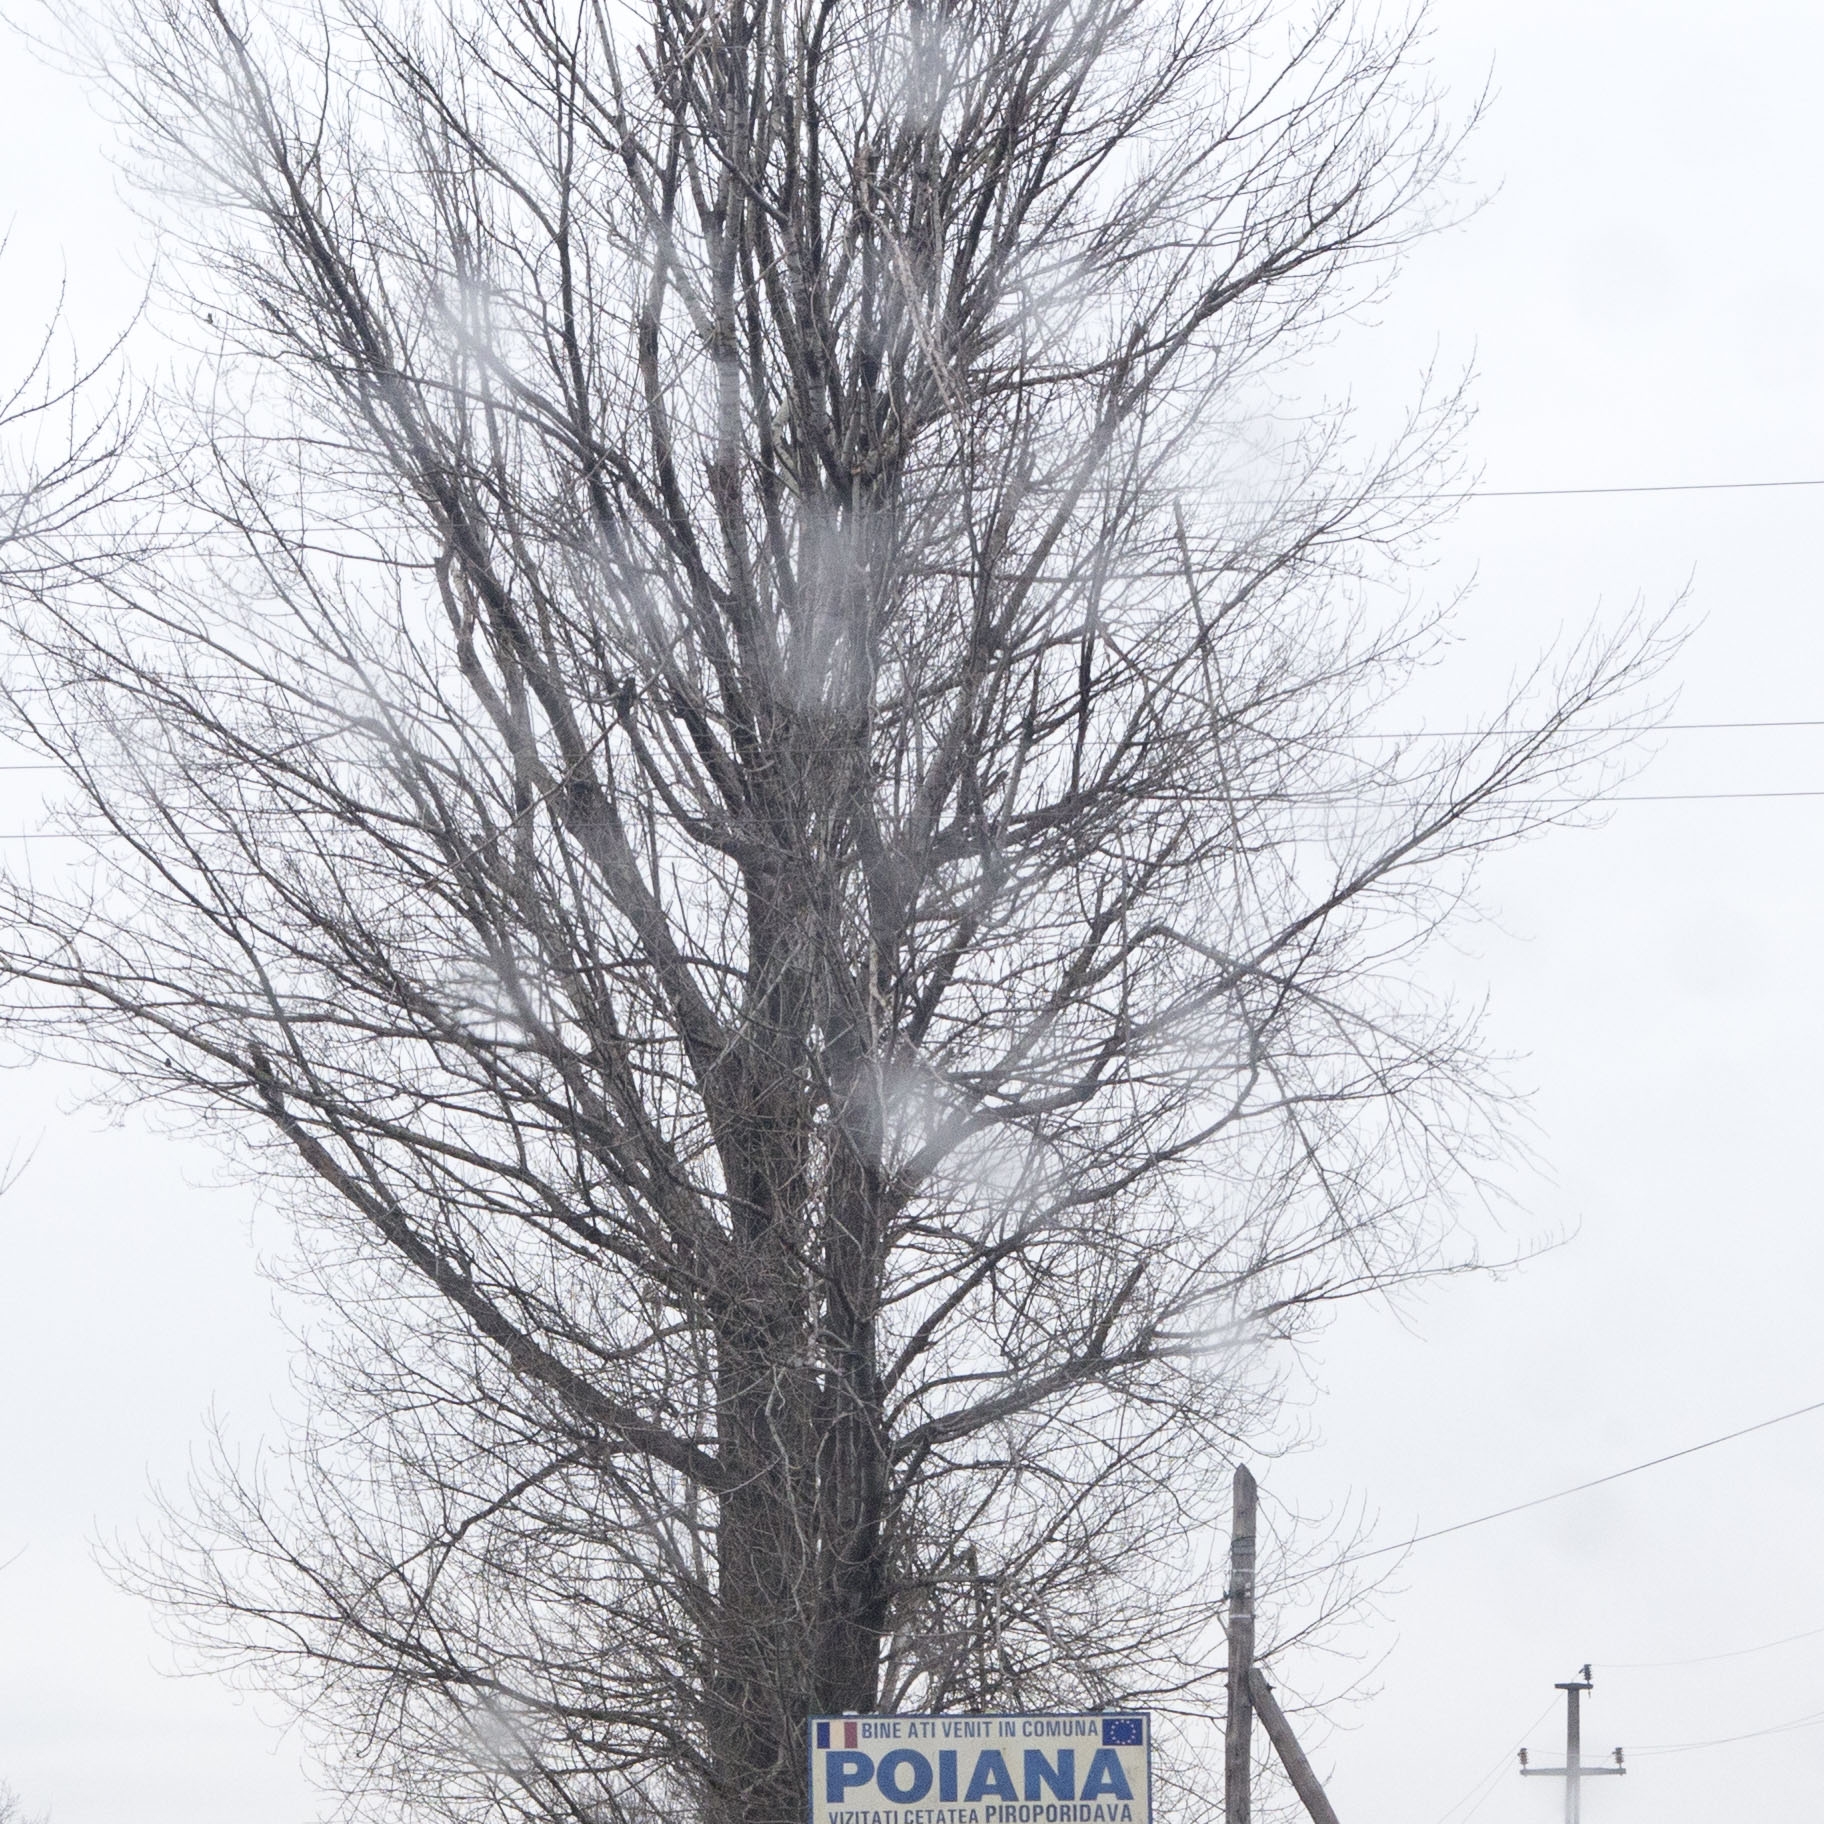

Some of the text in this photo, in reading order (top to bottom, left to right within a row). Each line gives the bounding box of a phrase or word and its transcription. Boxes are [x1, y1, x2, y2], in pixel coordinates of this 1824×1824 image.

[861, 1720, 1099, 1739] BINE ATI VENIT IN COMUNA
[826, 1748, 1134, 1804] POIANA
[903, 1808, 979, 1824] CETATEA
[985, 1803, 1133, 1823] PIROPORIDAVA
